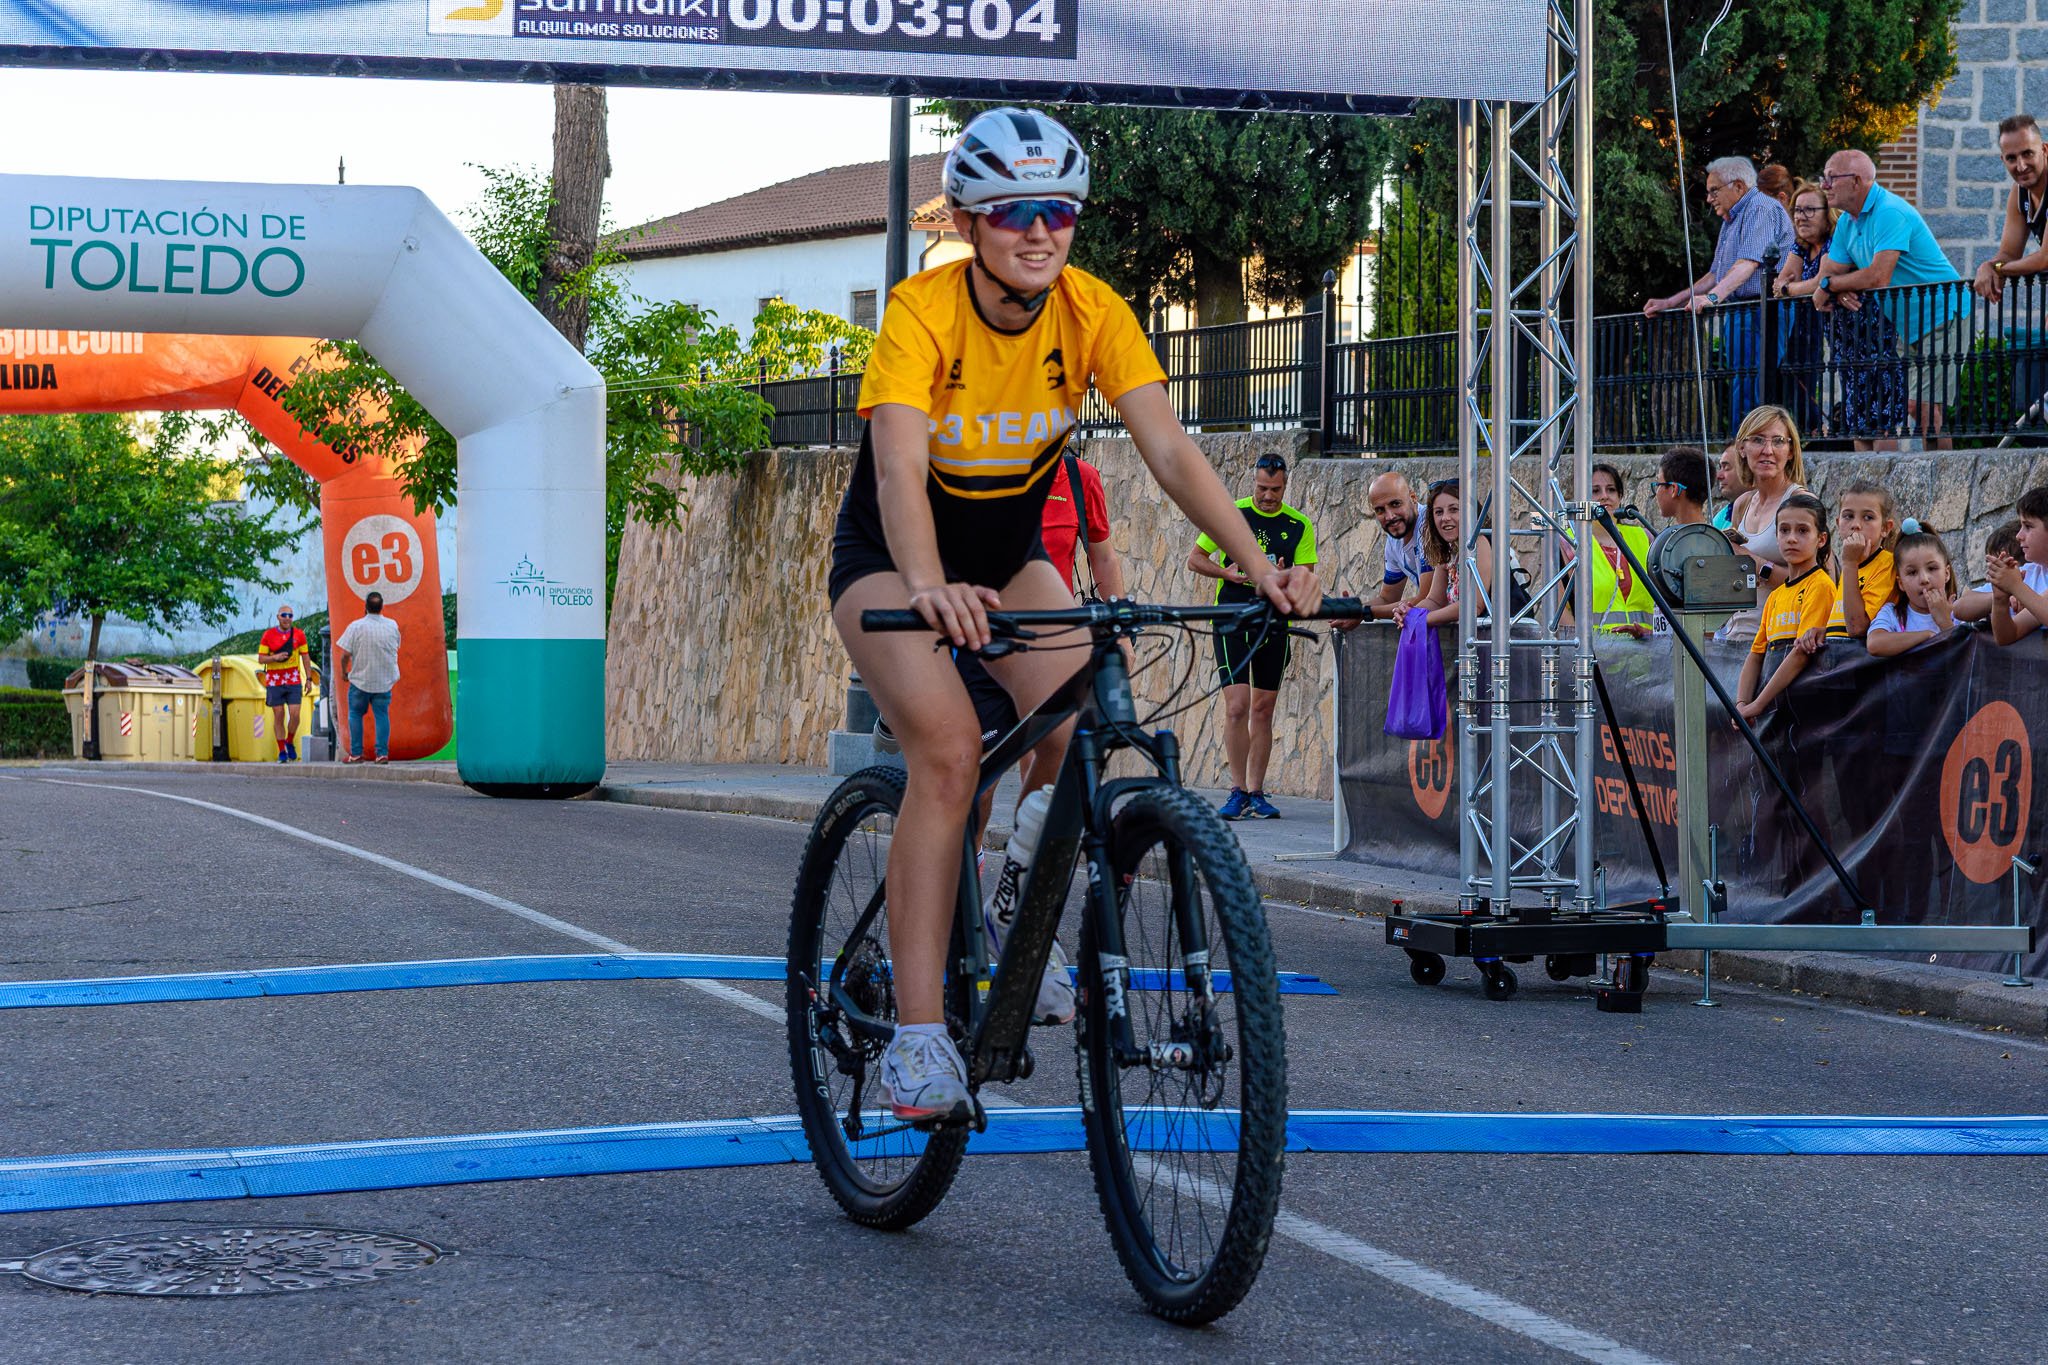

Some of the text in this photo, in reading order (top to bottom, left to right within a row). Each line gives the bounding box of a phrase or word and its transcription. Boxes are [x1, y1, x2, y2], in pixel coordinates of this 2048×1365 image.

[519, 19, 719, 40] ALQUILAMOS SOLUCIONES
[728, 0, 1061, 42] 00:03:04
[1026, 146, 1042, 157] 80
[30, 205, 306, 241] DIPUTACIÓN DE
[30, 238, 305, 298] TOLEDO
[0, 364, 58, 390] LIDA
[976, 406, 1076, 445] TEAM
[352, 532, 413, 585] e3
[549, 594, 593, 606] TOLEDO
[1958, 739, 2022, 846] e3
